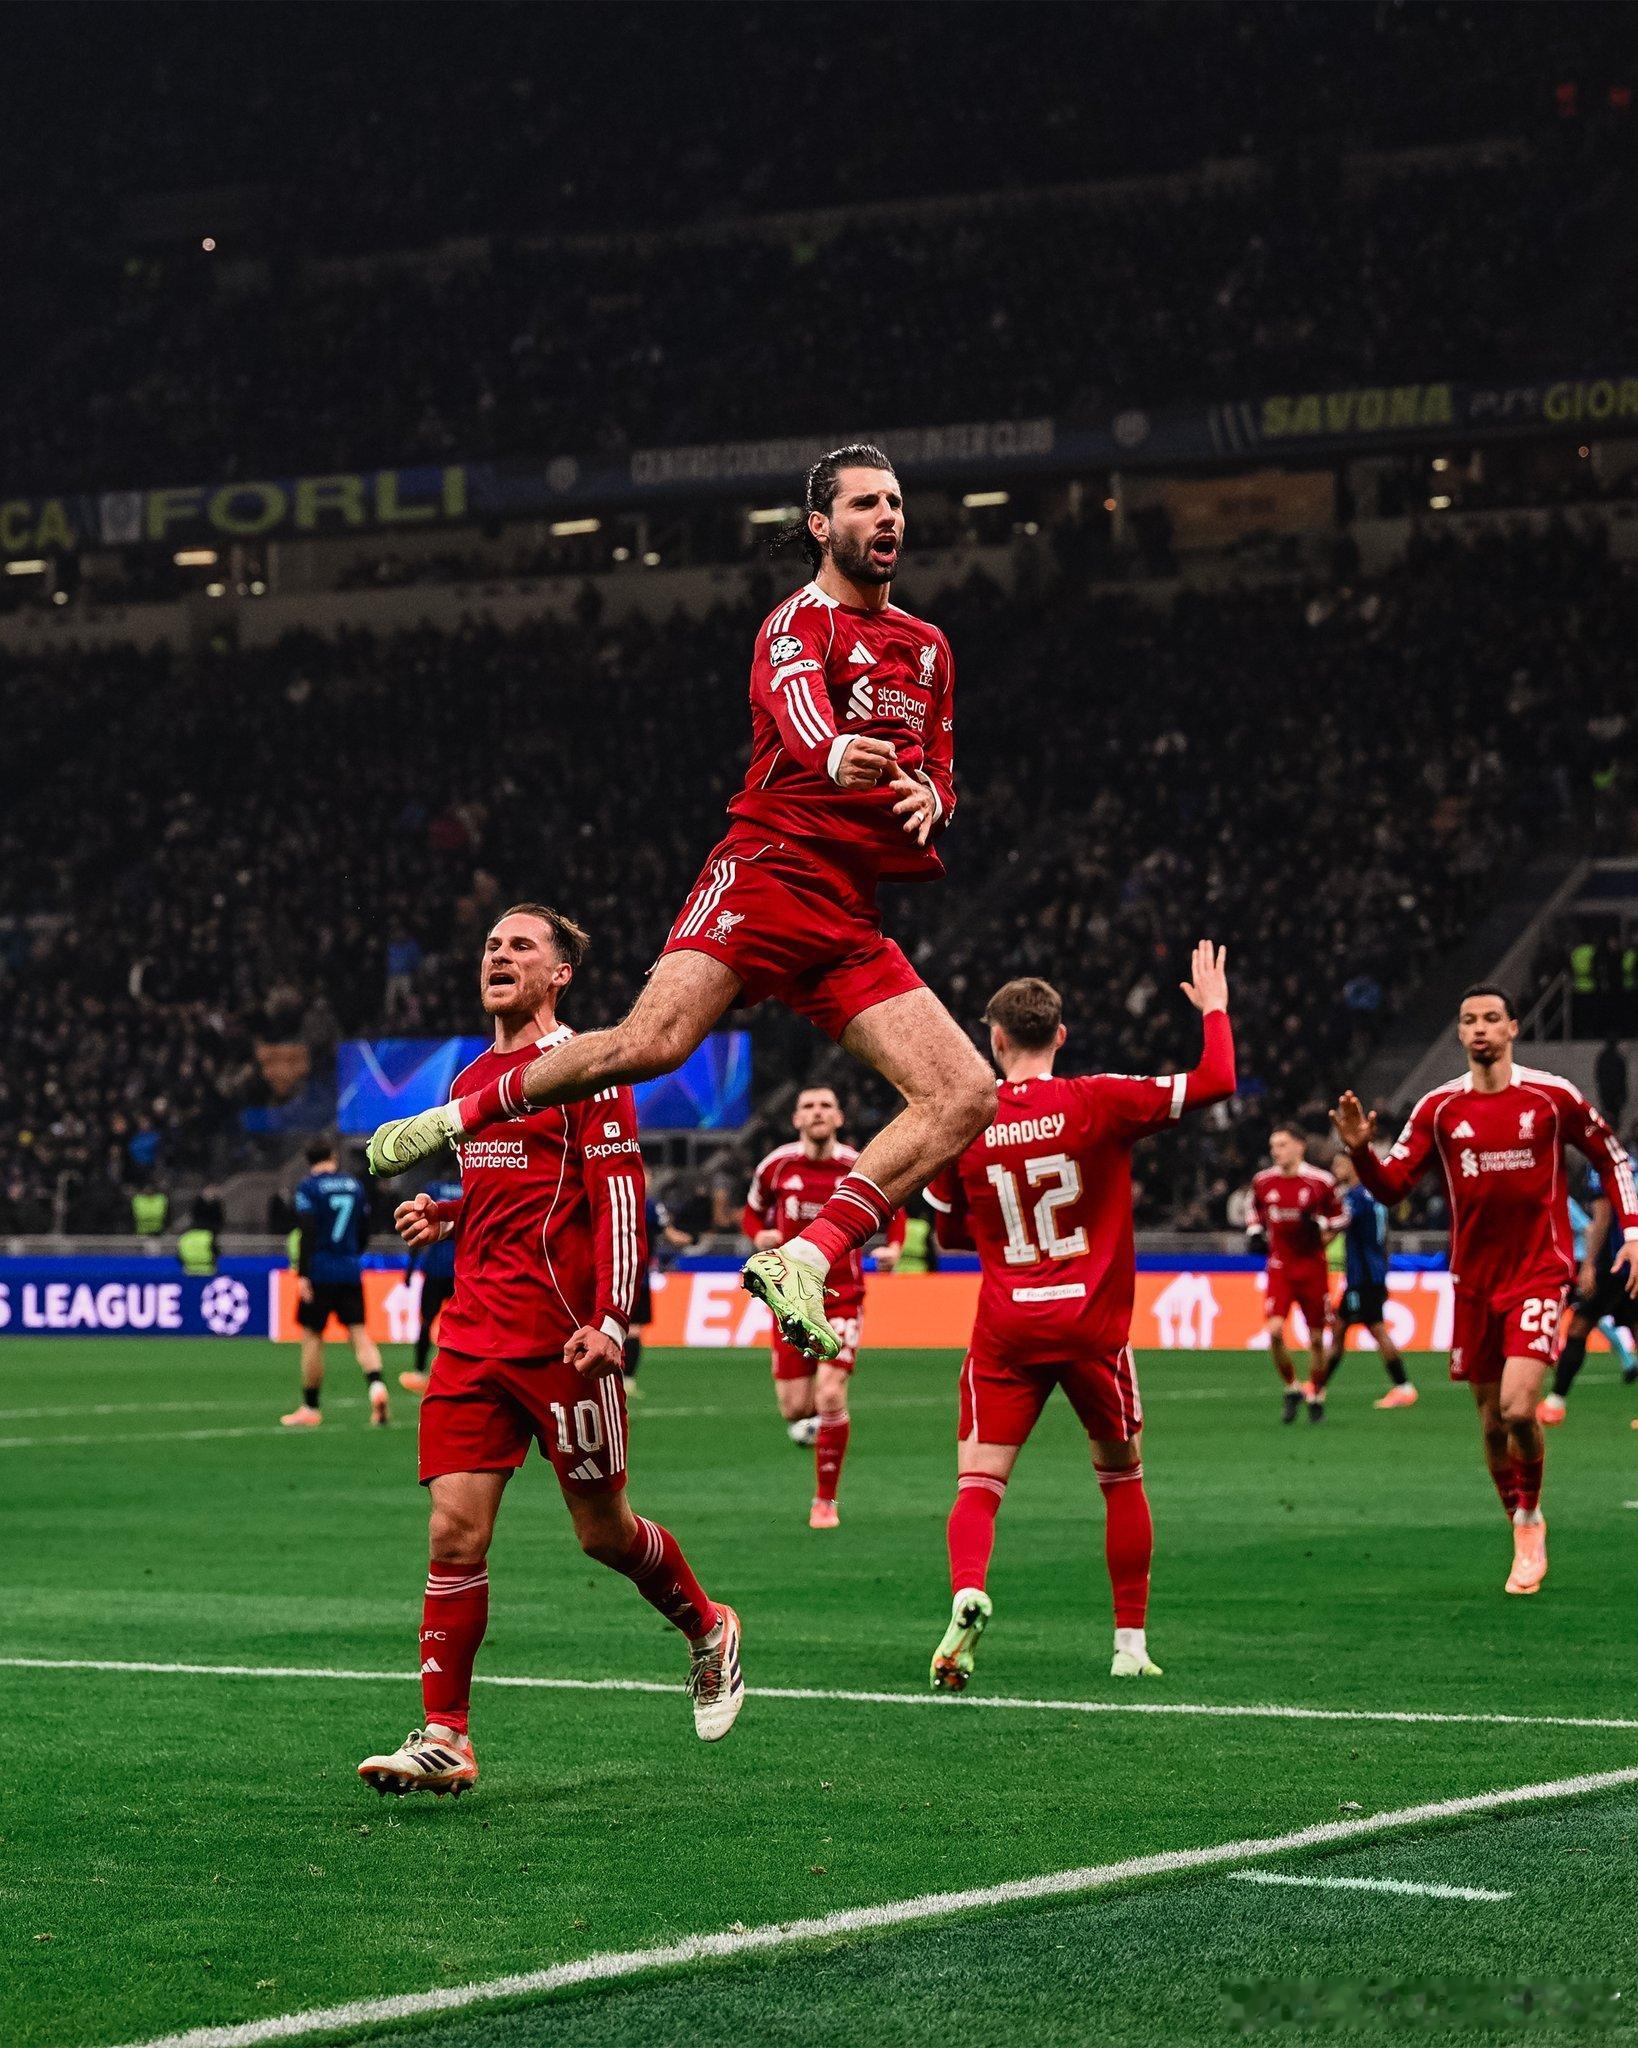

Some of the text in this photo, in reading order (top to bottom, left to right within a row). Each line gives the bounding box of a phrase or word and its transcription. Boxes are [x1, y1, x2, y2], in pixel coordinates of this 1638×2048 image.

[1262, 382, 1453, 439] SAVONA
[146, 465, 468, 541] FORLI
[464, 1139, 523, 1154] standard
[464, 1154, 528, 1169] chartered
[329, 1195, 354, 1243] 7
[985, 1152, 1090, 1266] 12
[22, 1283, 183, 1329] LEAGUE
[1520, 1297, 1558, 1337] 22
[550, 1399, 603, 1454] 10
